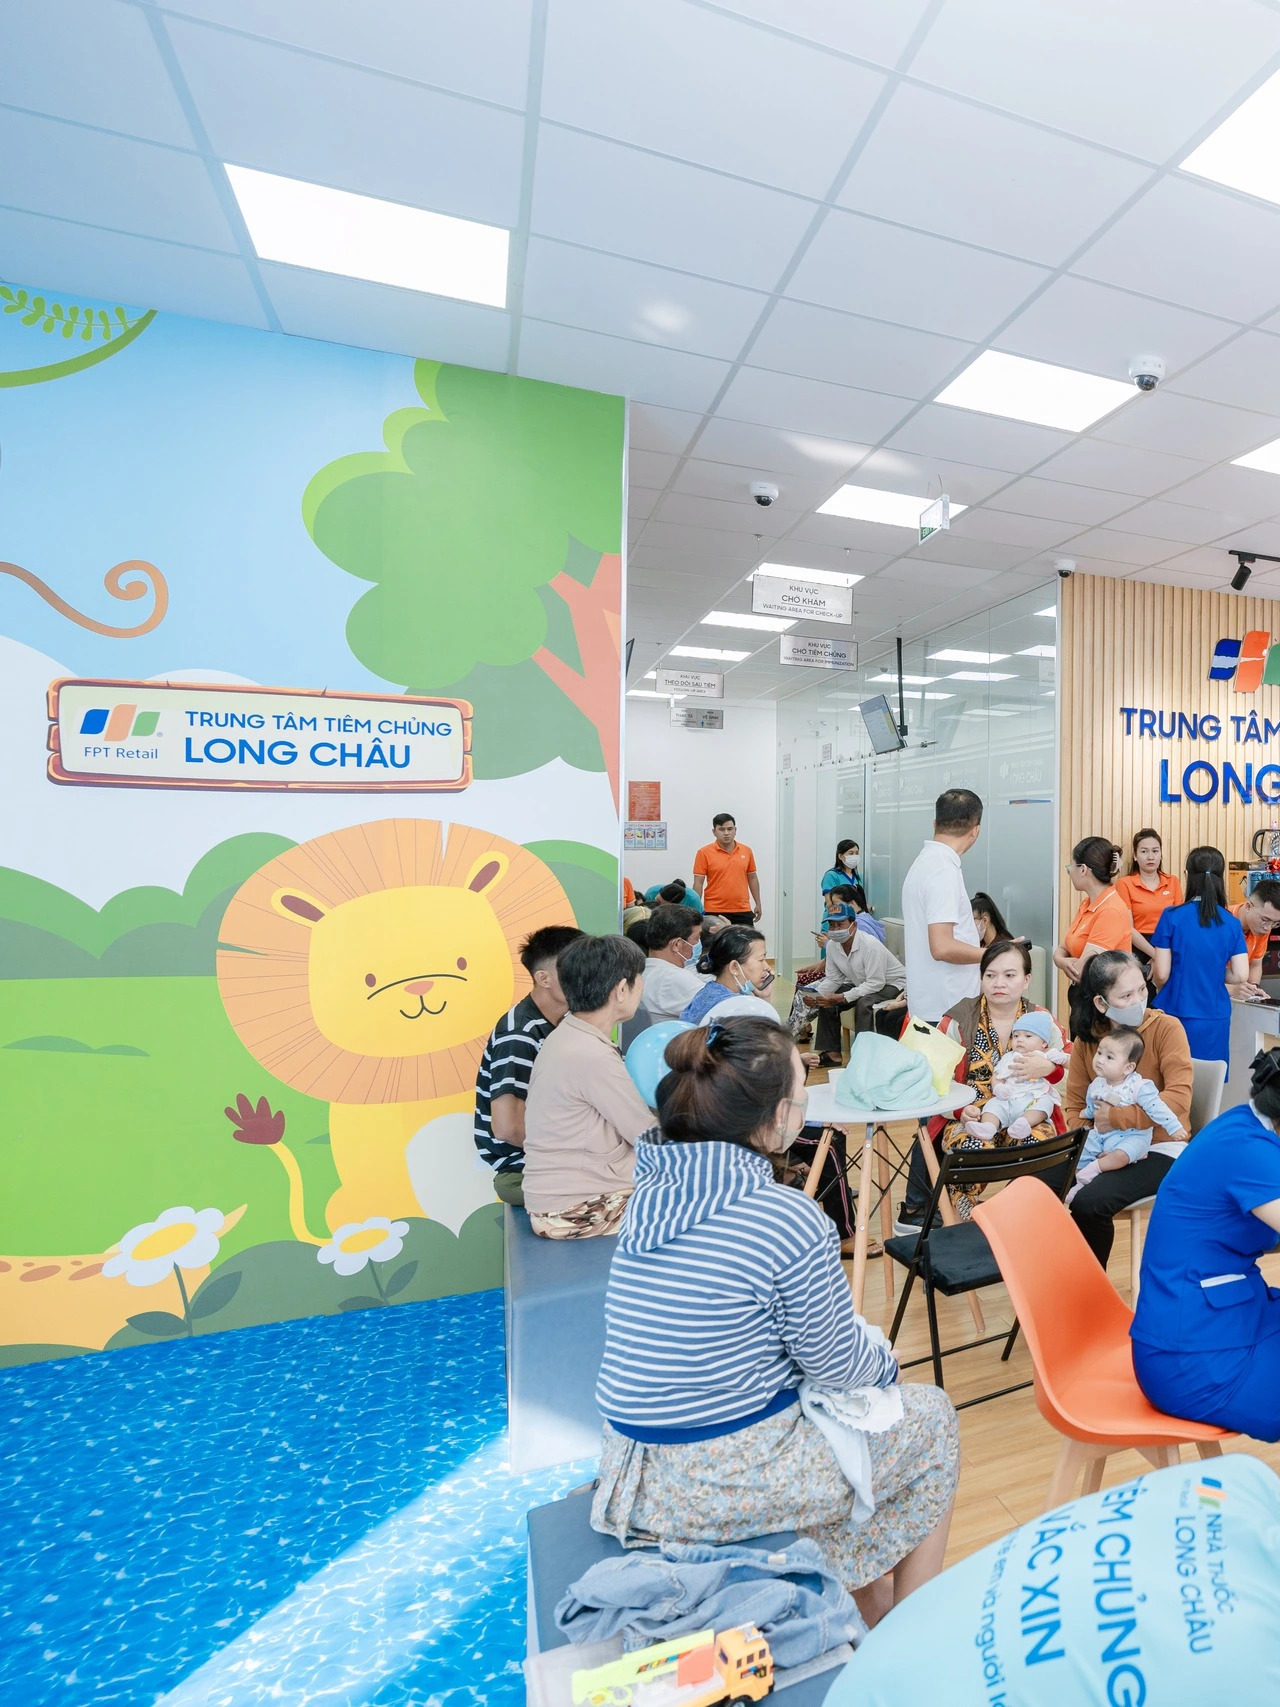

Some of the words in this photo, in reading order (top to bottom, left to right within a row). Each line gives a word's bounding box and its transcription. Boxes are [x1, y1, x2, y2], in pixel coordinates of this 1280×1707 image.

[789, 585, 804, 593] KHU
[804, 587, 819, 595] VỰC
[763, 603, 787, 611] WAITING
[815, 609, 843, 618] CHECK-UP
[185, 711, 265, 729] TRUNG
[272, 712, 318, 732] TÂM
[325, 715, 372, 734] TIÊM
[377, 716, 453, 737] CHỦNG
[1120, 707, 1222, 741] TRUNG
[84, 746, 110, 760] FPT
[115, 746, 159, 760] Retail
[185, 737, 298, 767] LONG
[310, 737, 411, 769] CHÂU
[1175, 1515, 1197, 1577] LONG
[1206, 1514, 1227, 1554] NHÀ
[1021, 1575, 1065, 1666] XIN
[1093, 1533, 1147, 1707] CHỦNG
[1180, 1584, 1215, 1655] CHÂU
